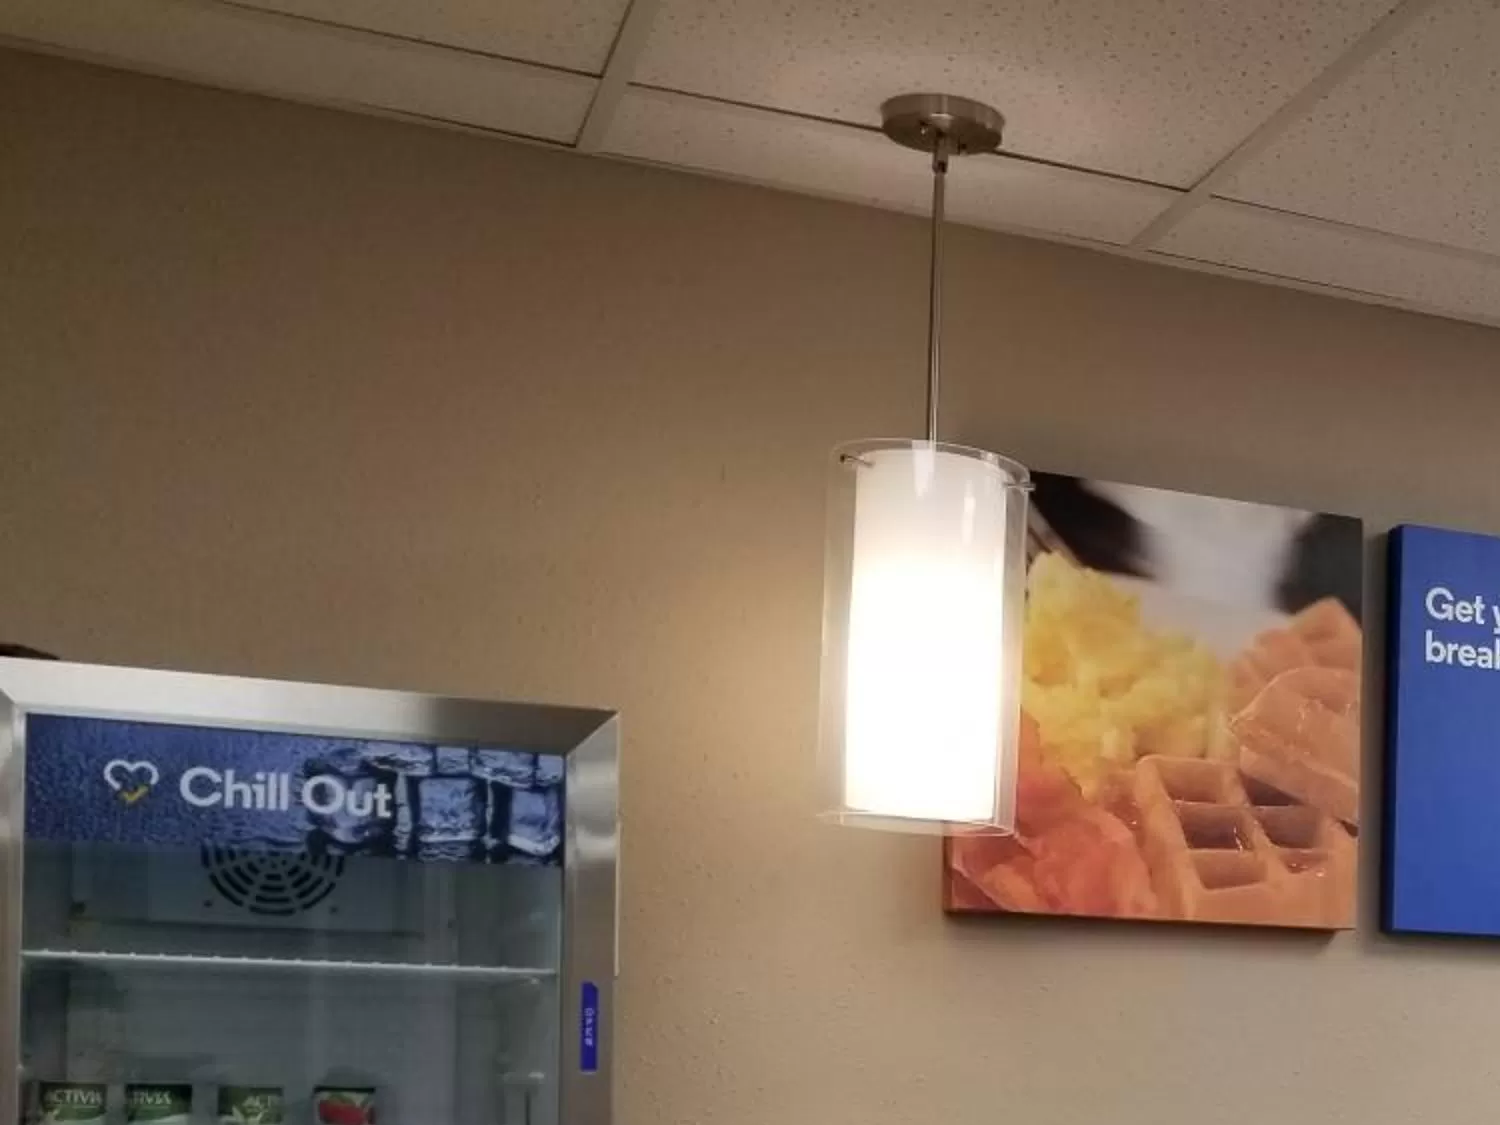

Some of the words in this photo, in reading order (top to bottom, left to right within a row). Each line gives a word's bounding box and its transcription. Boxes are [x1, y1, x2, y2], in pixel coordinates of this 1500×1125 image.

[1425, 586, 1485, 625] Get
[180, 766, 289, 811] Chill
[302, 774, 392, 818] Out
